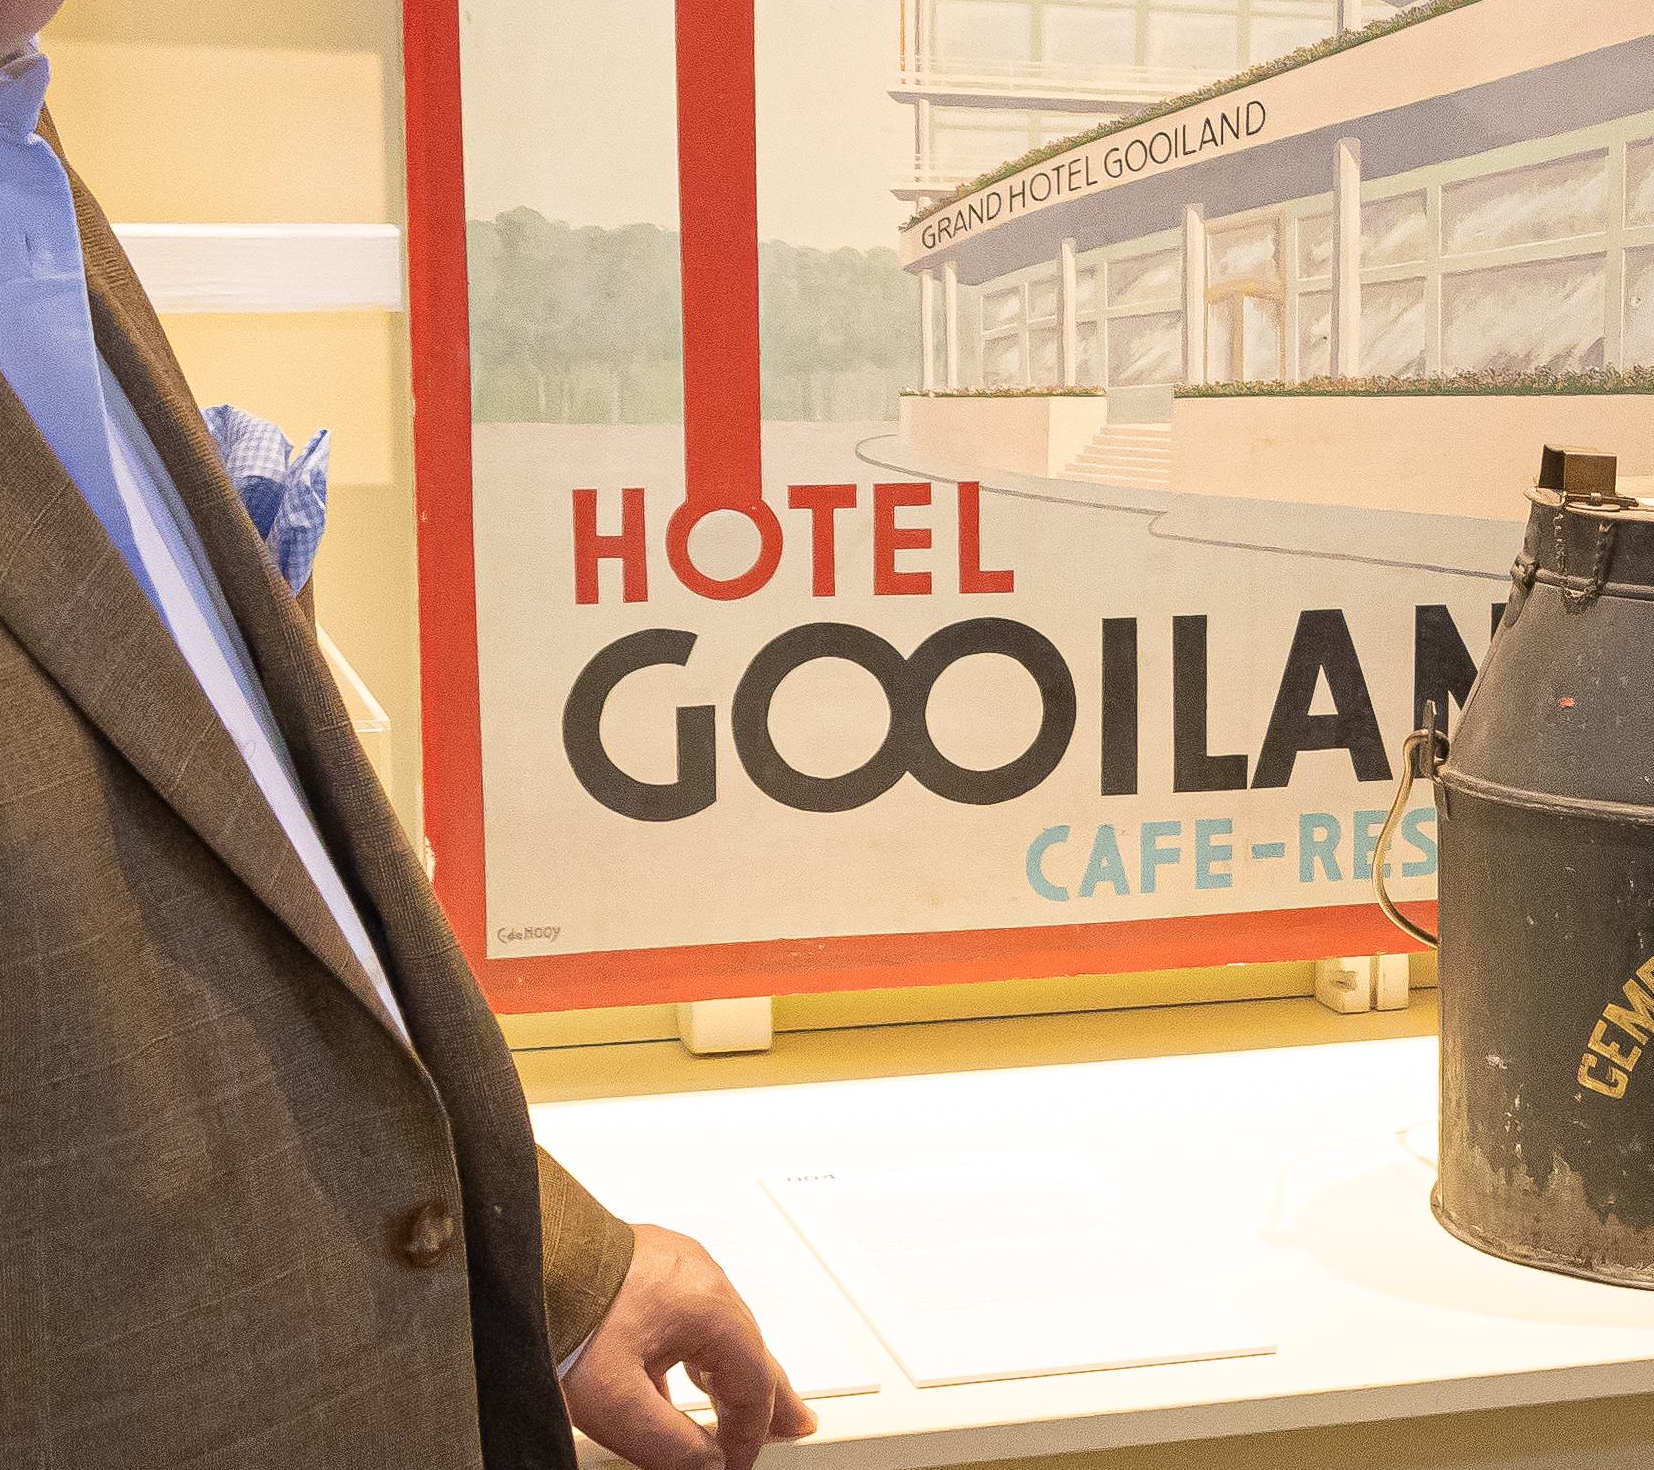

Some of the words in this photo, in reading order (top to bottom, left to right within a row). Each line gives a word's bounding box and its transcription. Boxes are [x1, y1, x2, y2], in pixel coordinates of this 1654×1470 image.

[921, 190, 1004, 250] GRAND
[1008, 155, 1098, 214] HOTEL
[1103, 100, 1267, 179] GOOILAND
[571, 480, 1015, 605] HOTEL
